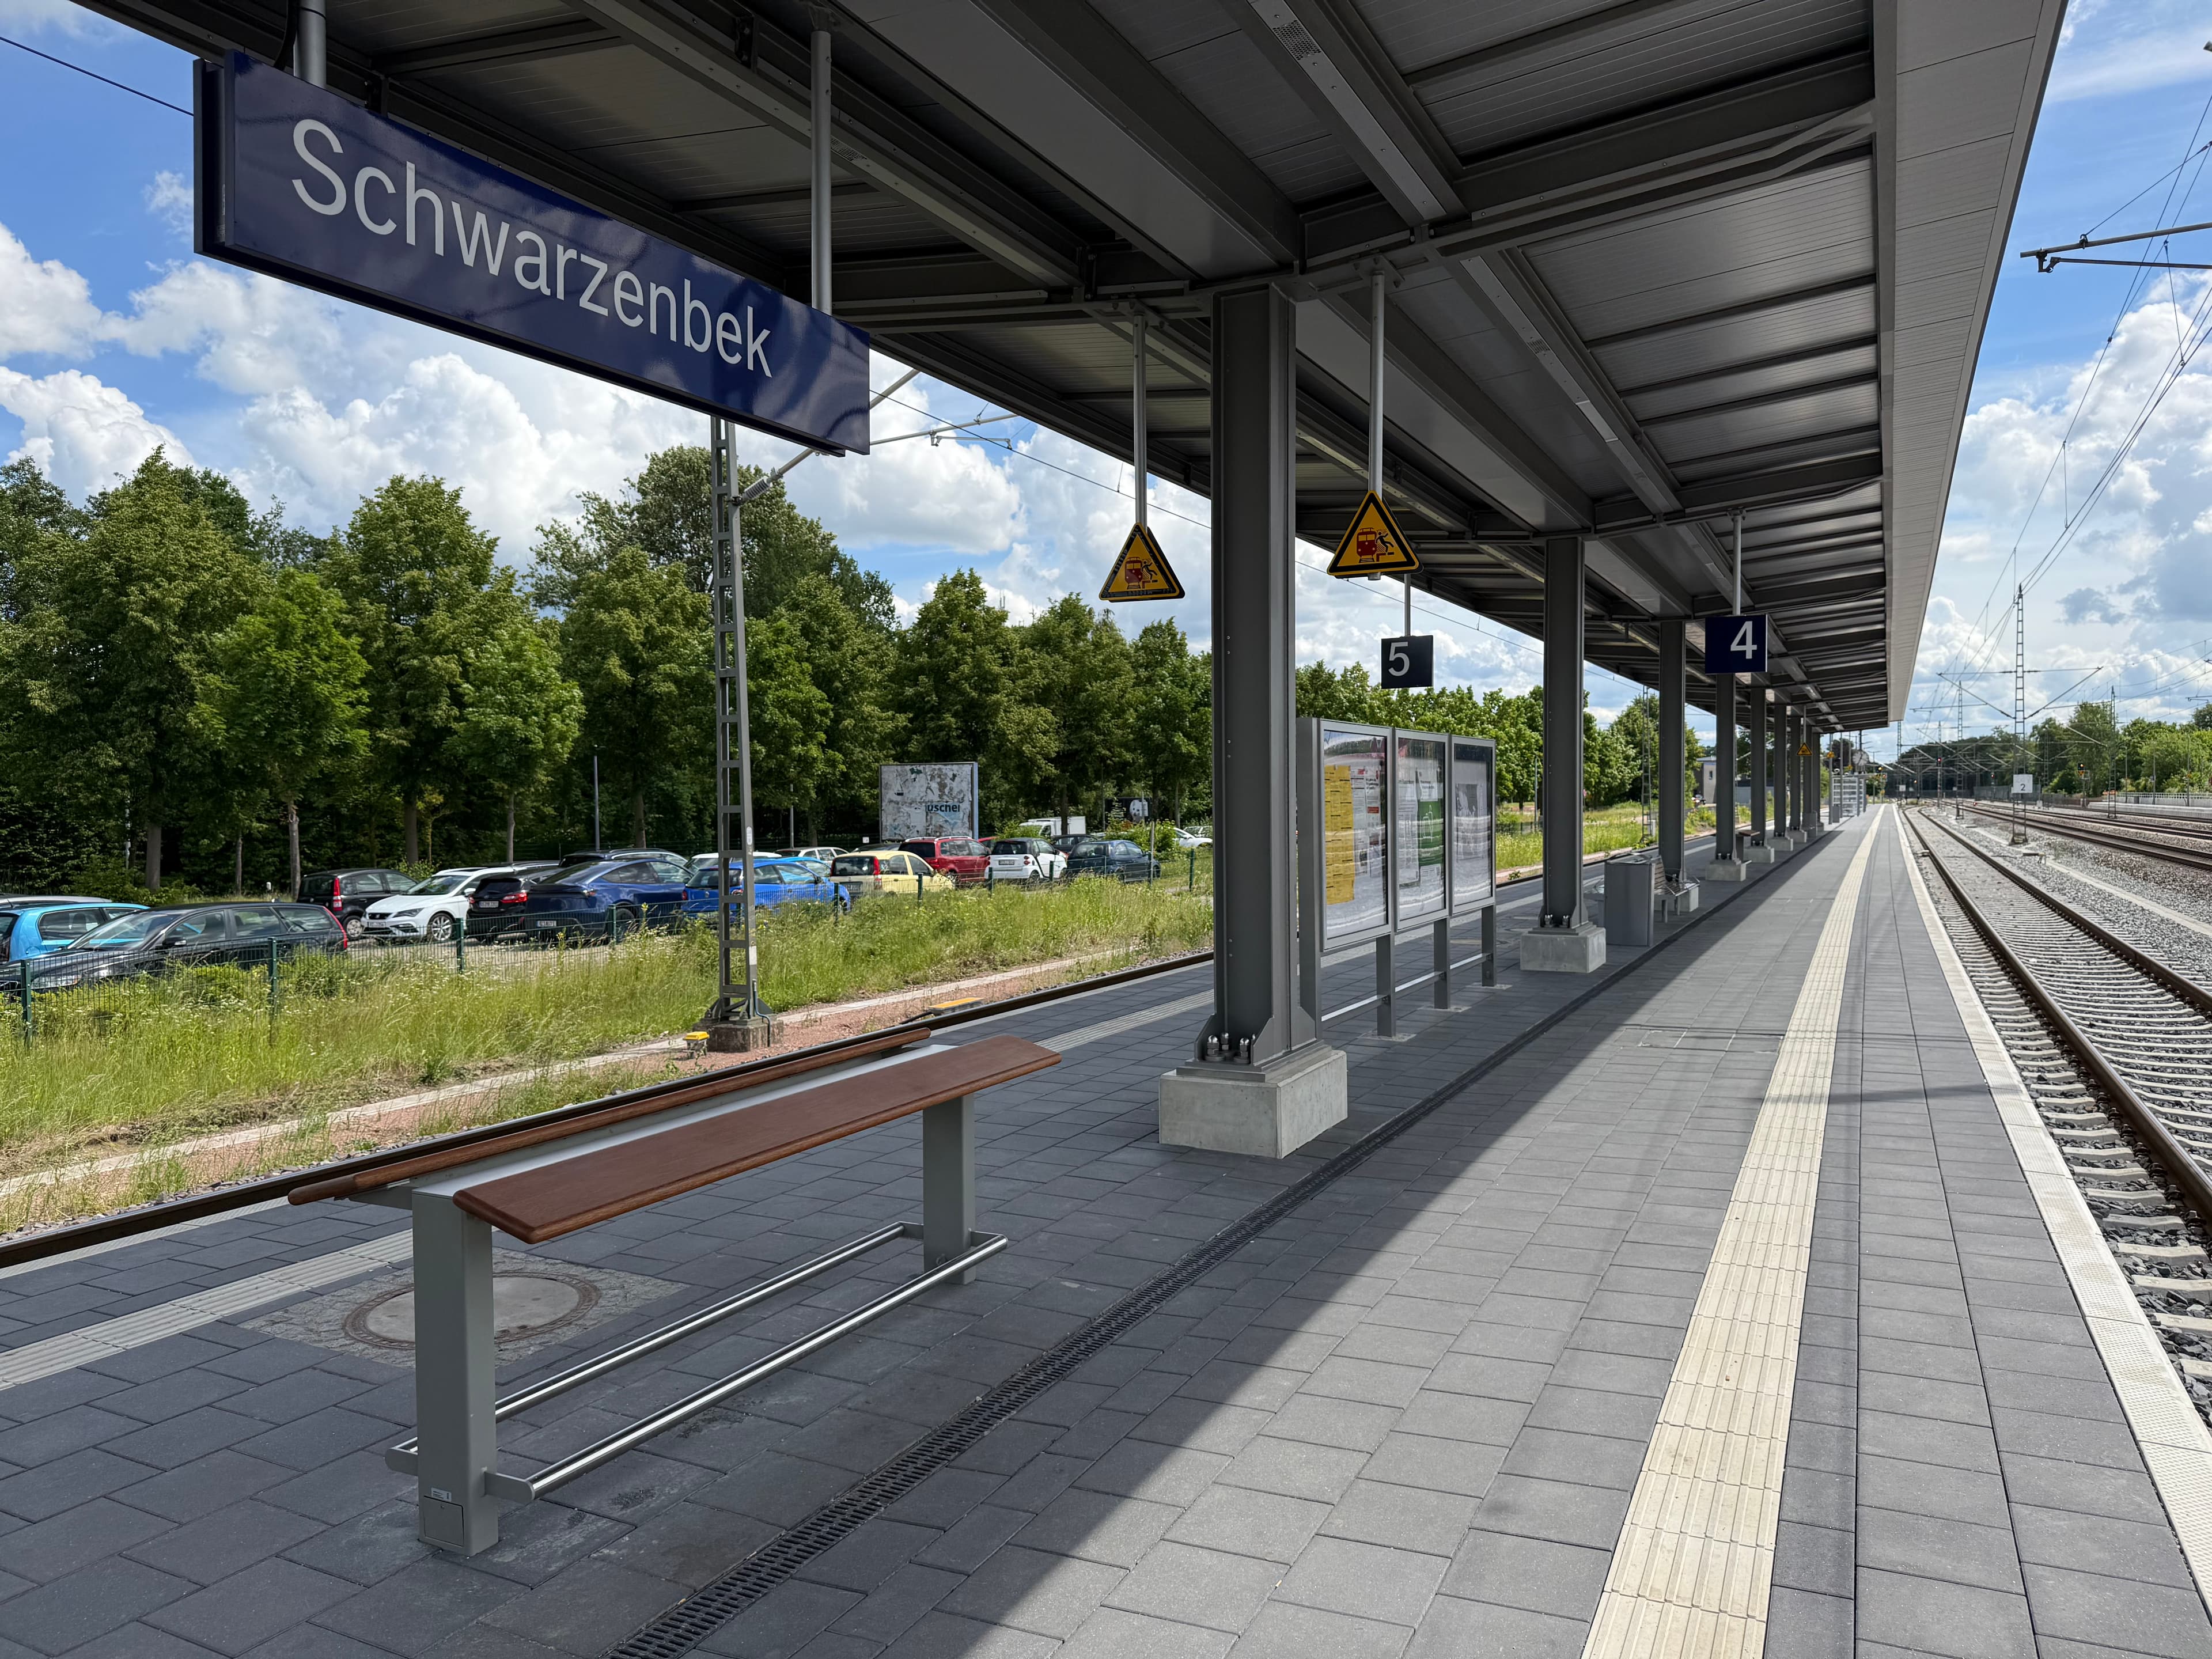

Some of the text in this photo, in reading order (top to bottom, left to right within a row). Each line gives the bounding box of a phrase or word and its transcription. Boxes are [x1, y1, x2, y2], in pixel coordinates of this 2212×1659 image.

[291, 119, 772, 378] Schwarzenbek
[1388, 641, 1410, 677] 5
[1730, 621, 1758, 660] 4
